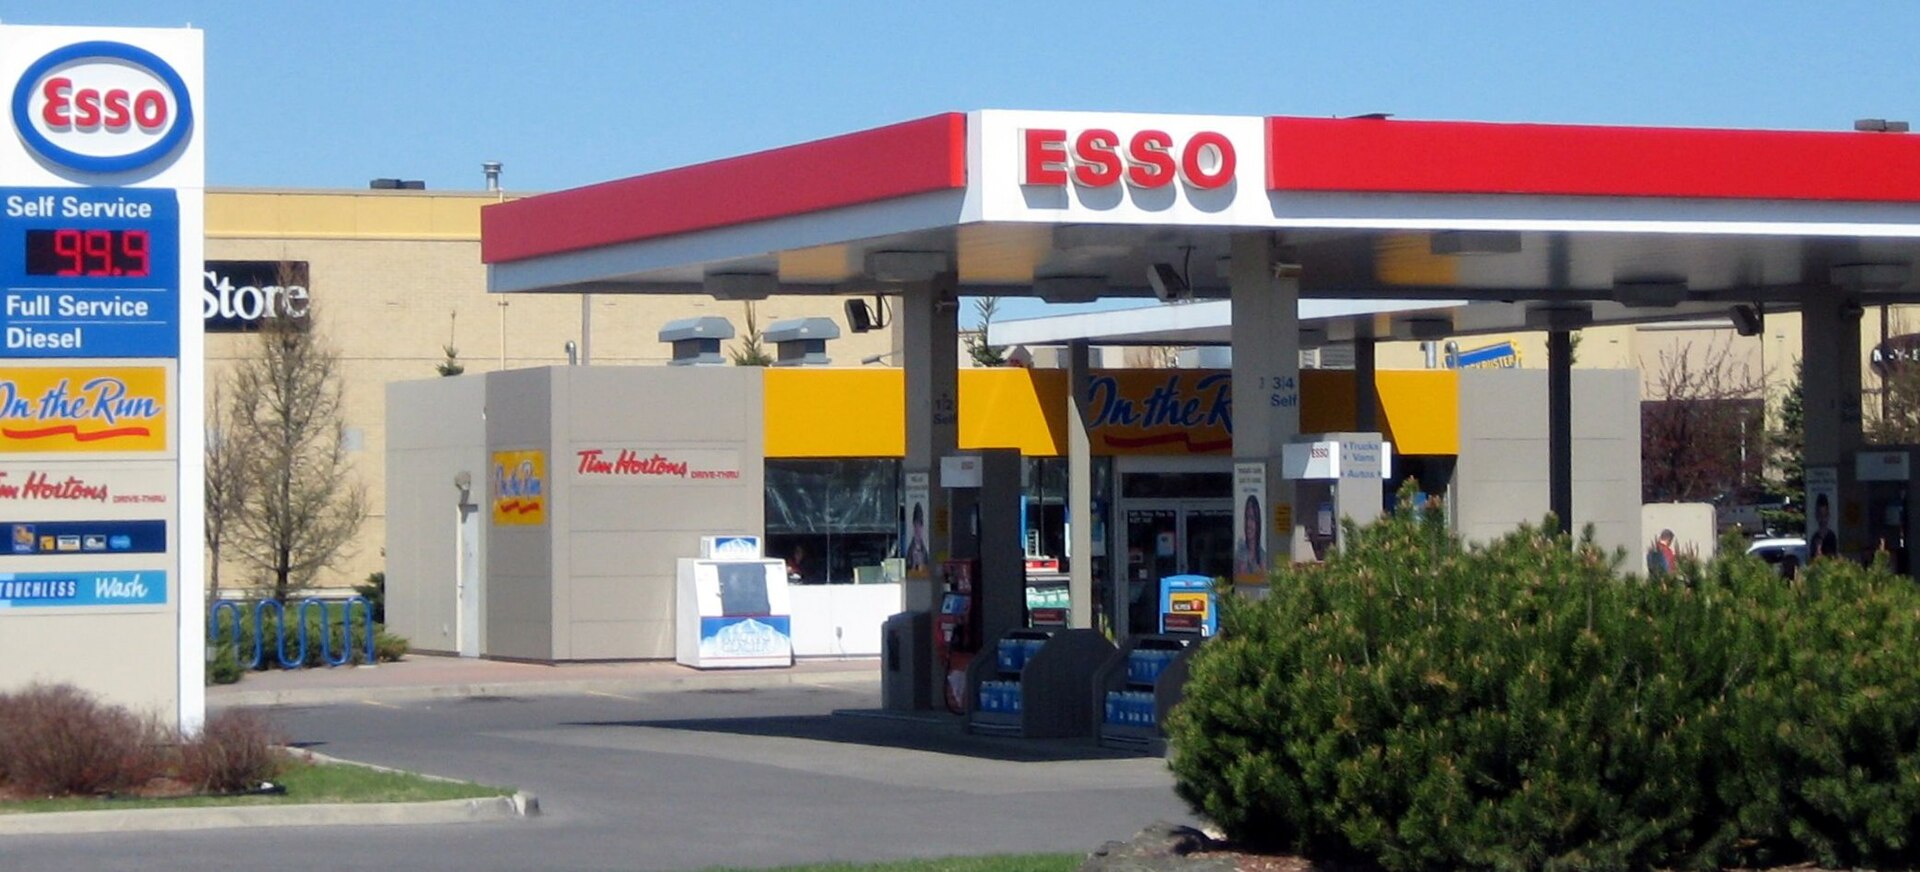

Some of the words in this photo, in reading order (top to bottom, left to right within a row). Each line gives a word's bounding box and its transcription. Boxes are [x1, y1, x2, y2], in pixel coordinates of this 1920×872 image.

[1024, 128, 1237, 189] ESSO
[6, 196, 55, 217] Self
[61, 196, 152, 218] Service
[54, 228, 149, 277] 99.9
[6, 294, 51, 316] Full
[58, 295, 149, 317] Service
[203, 270, 310, 320] Store
[6, 327, 82, 349] Diesel
[38, 379, 90, 419] the
[83, 378, 161, 425] Run
[1141, 375, 1205, 427] the
[1271, 393, 1297, 407] Self
[577, 449, 613, 474] Tim
[615, 448, 688, 478] Hortons
[22, 470, 108, 502] Hortons
[95, 573, 148, 599] Wash
